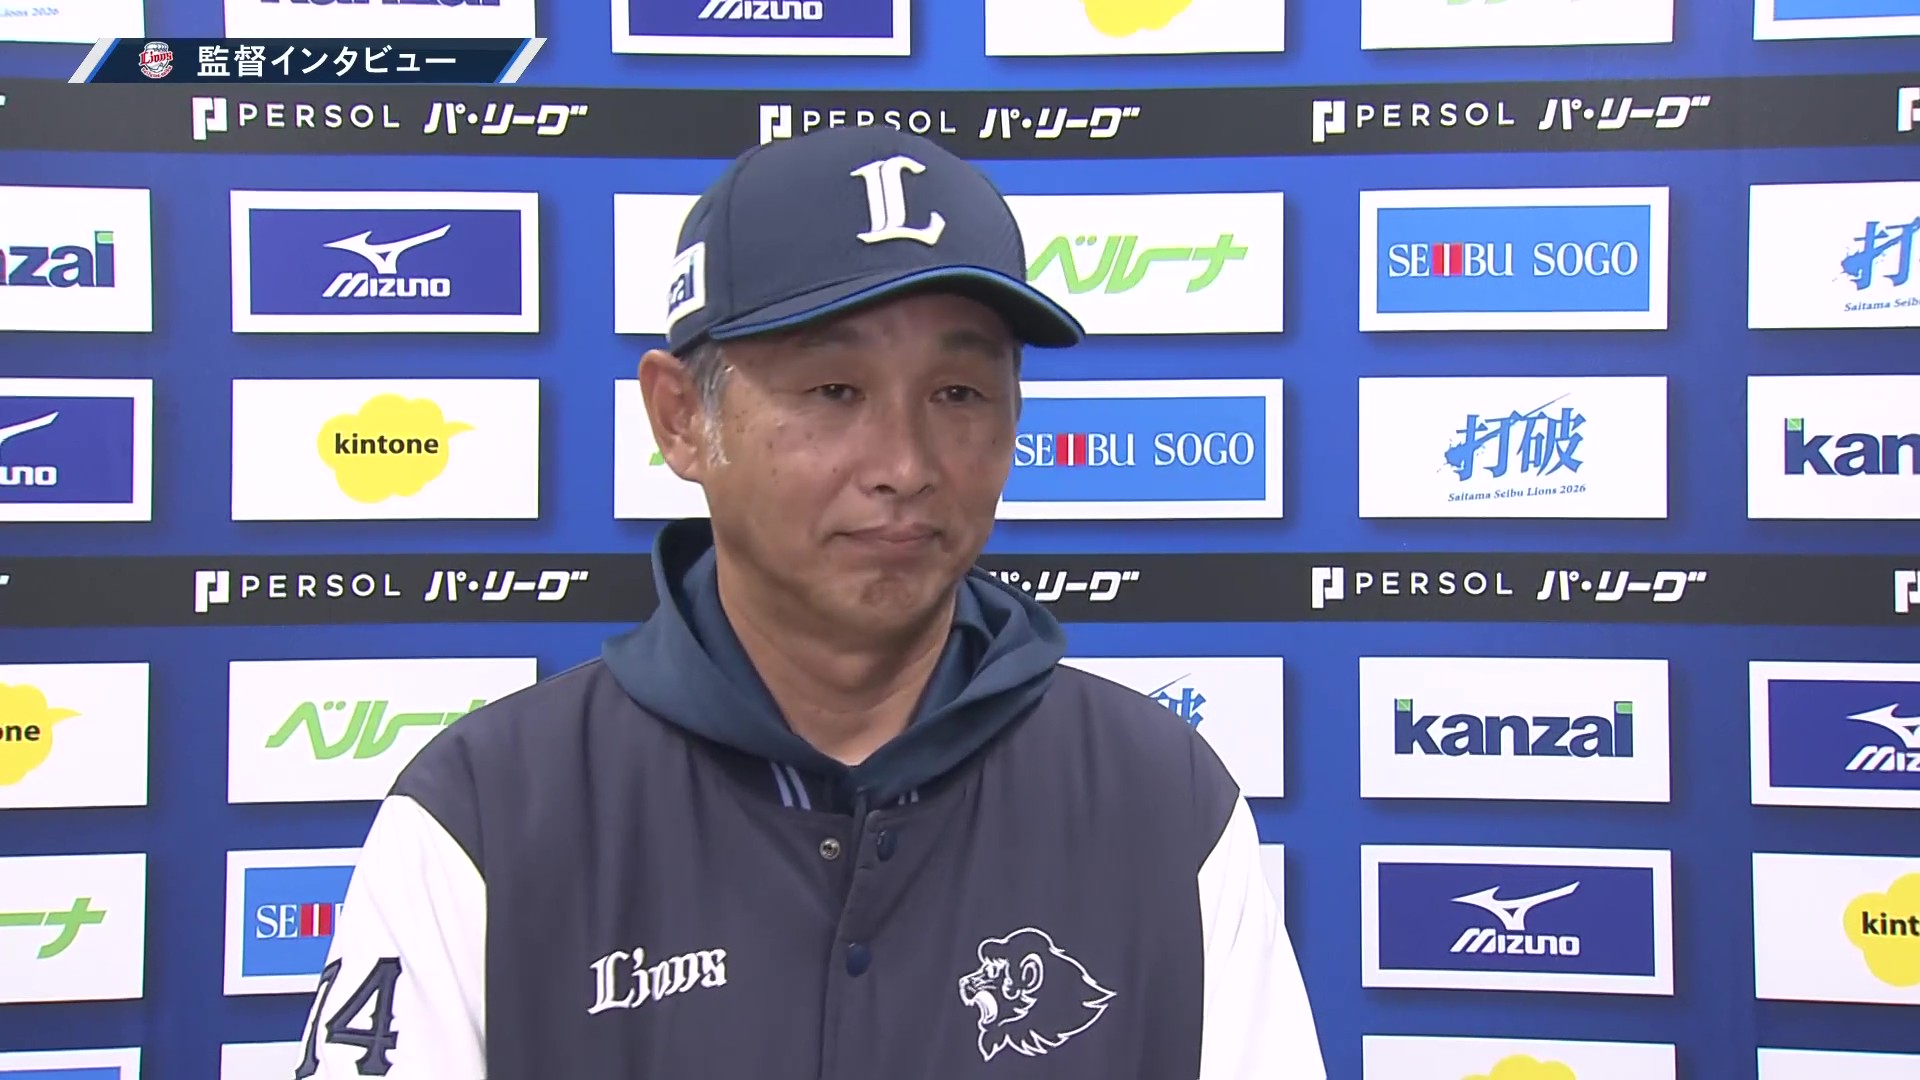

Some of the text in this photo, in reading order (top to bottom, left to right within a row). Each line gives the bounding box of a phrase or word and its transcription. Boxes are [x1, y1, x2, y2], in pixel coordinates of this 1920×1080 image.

[238, 103, 400, 128] PERSOL
[1356, 101, 1515, 128] PERSOL
[849, 155, 947, 247] L
[1025, 233, 1249, 295] ベルーナ
[1387, 242, 1638, 278] SEIBU SOGO
[1844, 297, 1920, 312] Saitama Seib
[334, 432, 440, 456] kintone
[1014, 431, 1255, 467] SEIBU SOGO
[1442, 403, 1587, 482] 打破
[1447, 483, 1587, 502] Saitama Seibu Lions 2026
[241, 573, 401, 598] PERSOL
[1355, 572, 1513, 596] PERSOL
[0, 725, 41, 742] ne
[265, 700, 486, 760] ベルー
[1394, 698, 1634, 758] kanzai
